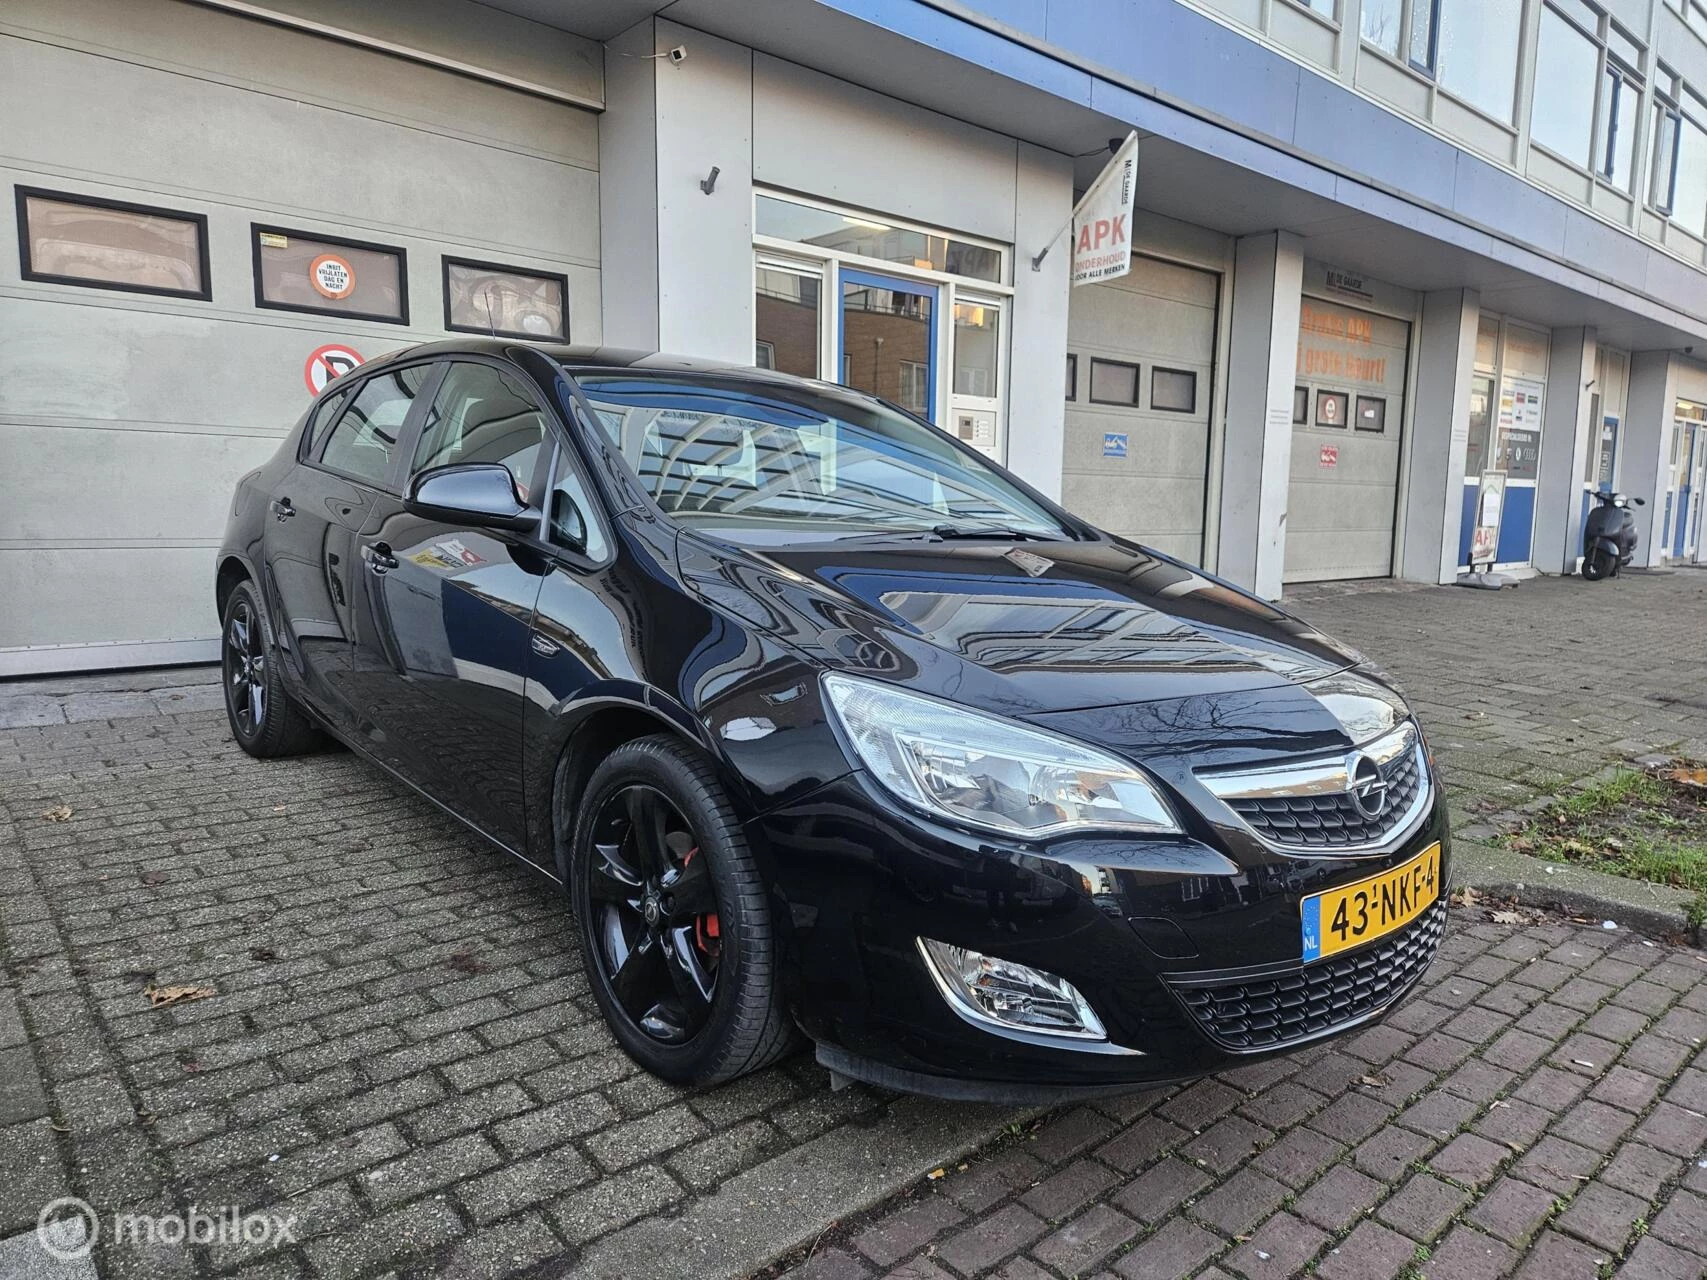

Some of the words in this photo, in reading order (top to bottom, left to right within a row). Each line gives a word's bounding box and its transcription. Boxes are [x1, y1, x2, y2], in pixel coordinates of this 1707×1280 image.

[1077, 213, 1127, 255] APK
[318, 268, 348, 278] VRIJLATEN
[326, 263, 341, 271] INRIT
[1088, 269, 1102, 279] ALLE
[1103, 263, 1126, 276] MERKEN
[325, 282, 343, 290] NACHT
[1331, 856, 1435, 942] 43-NKF-4
[1304, 936, 1318, 950] NL
